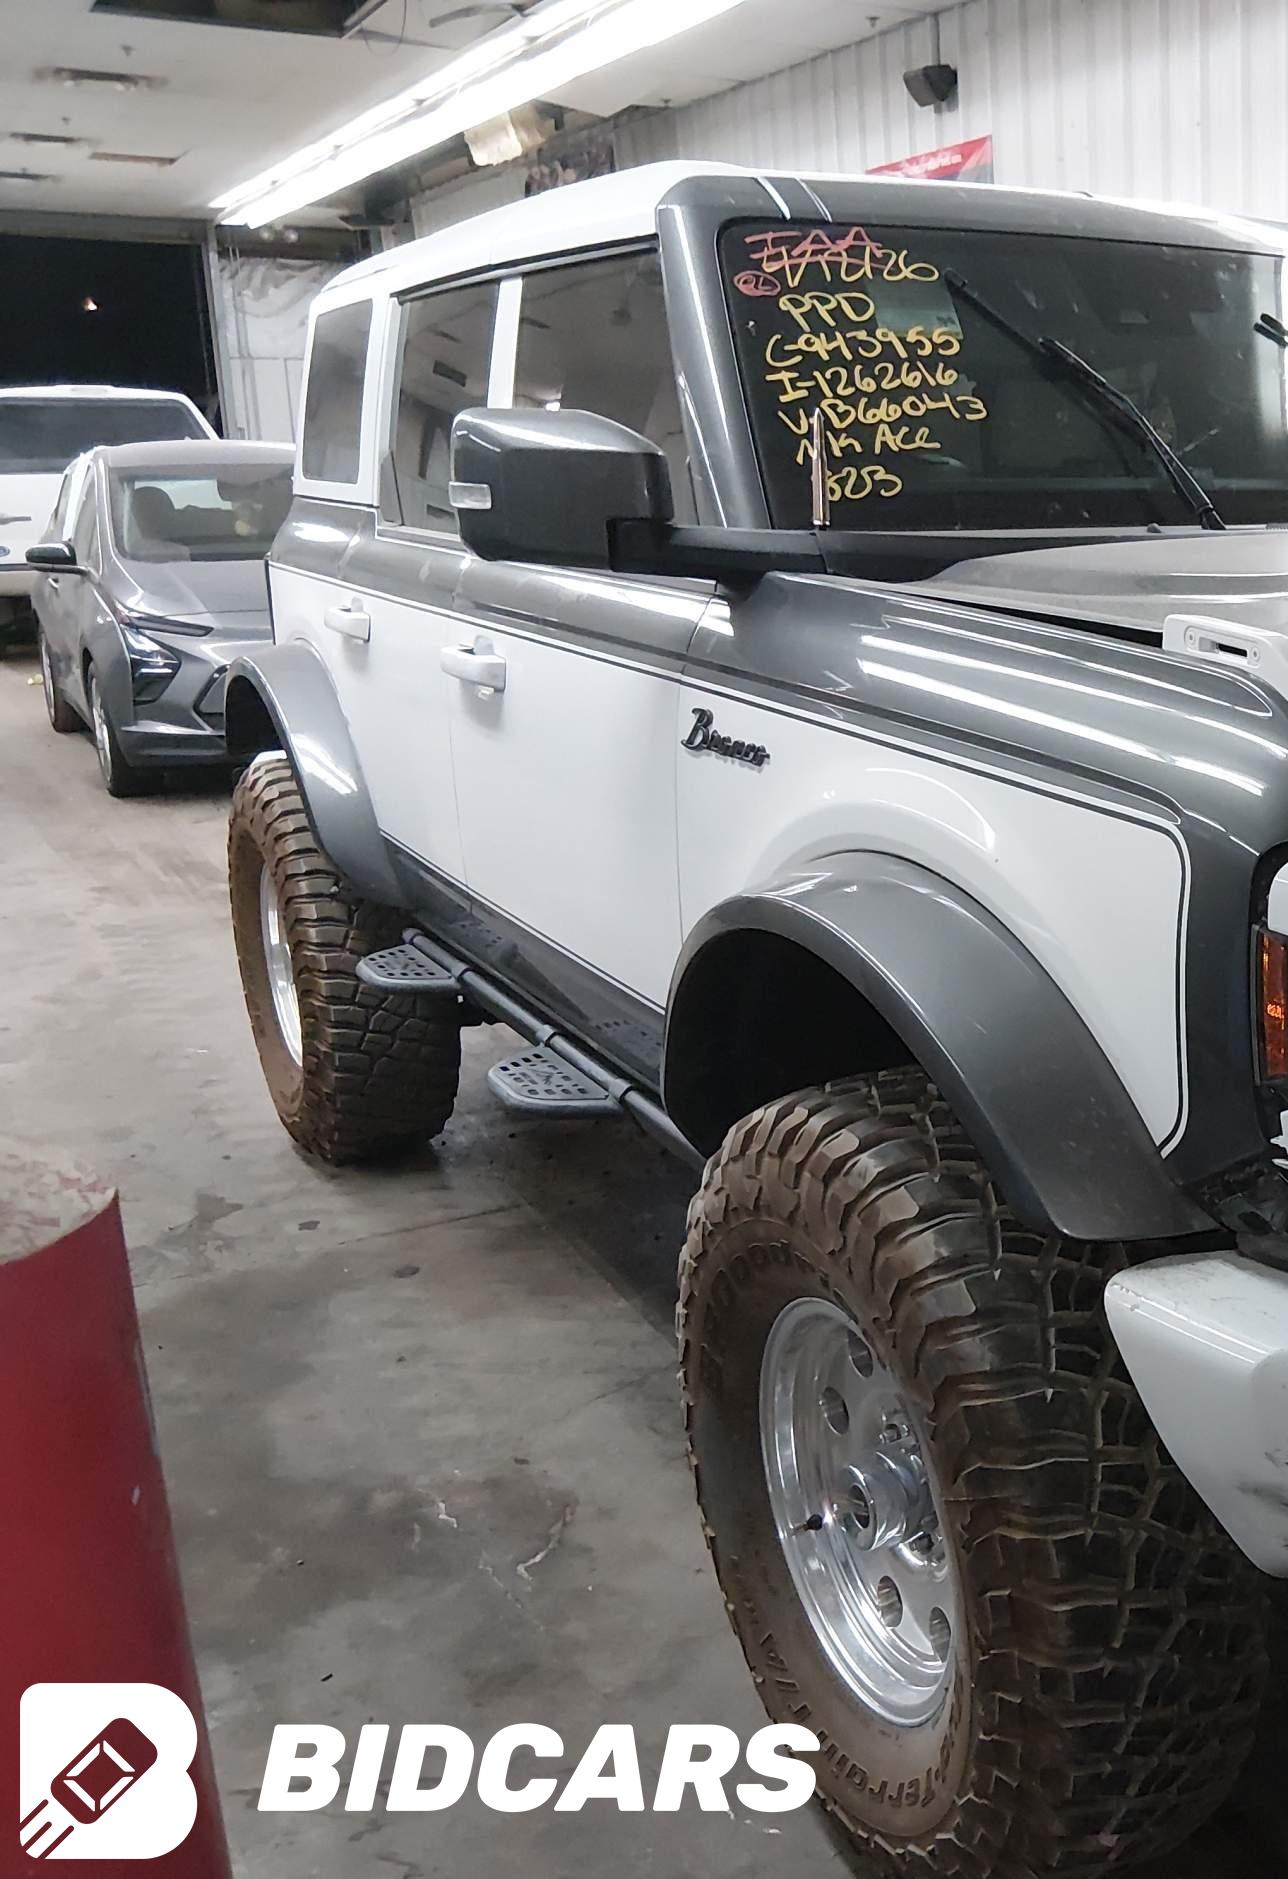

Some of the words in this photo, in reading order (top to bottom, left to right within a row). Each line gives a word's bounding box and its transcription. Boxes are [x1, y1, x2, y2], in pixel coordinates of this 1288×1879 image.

[744, 226, 883, 259] IAA
[778, 291, 875, 332] PPD
[680, 707, 771, 768] Bronco
